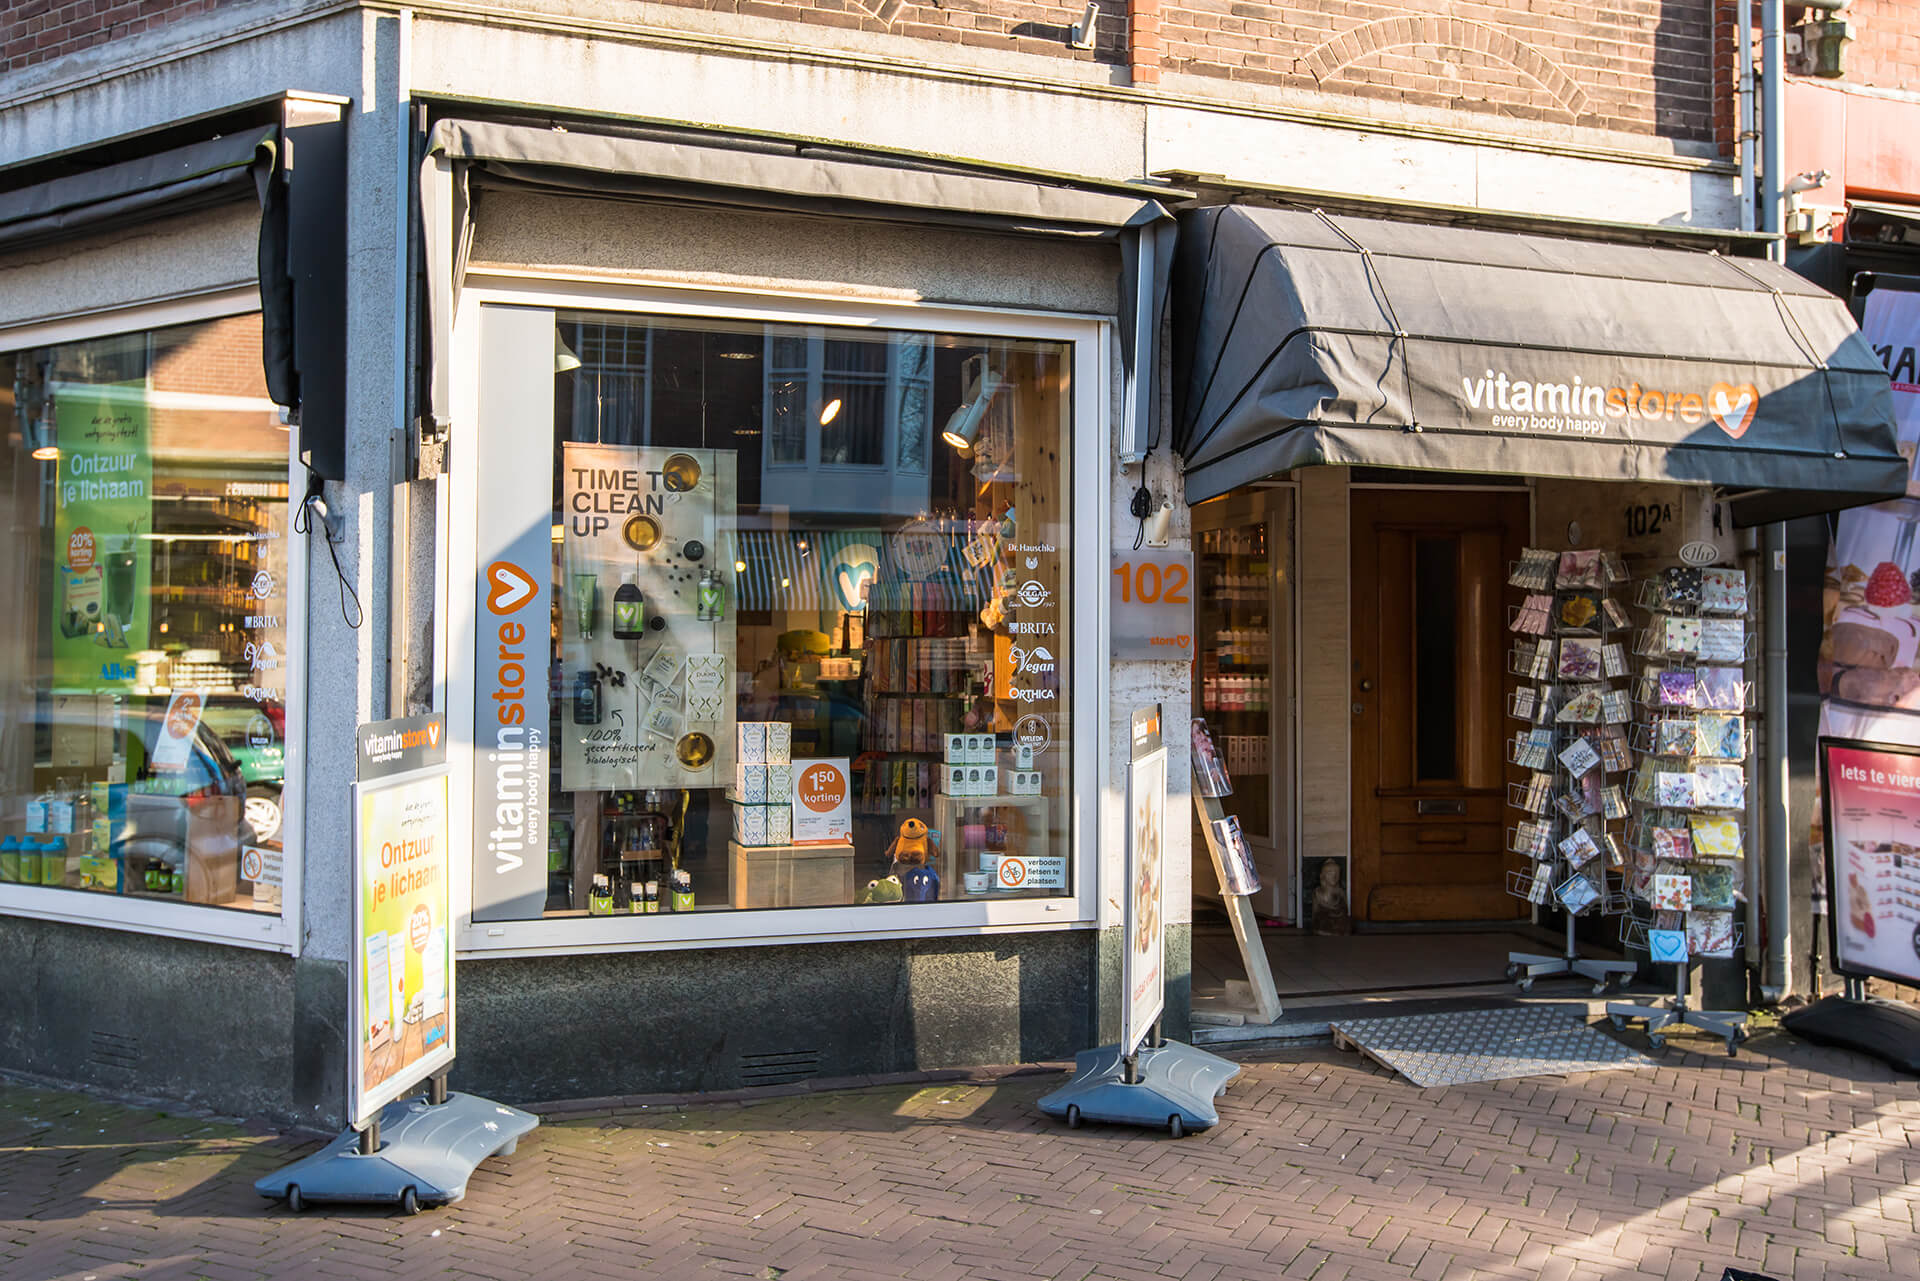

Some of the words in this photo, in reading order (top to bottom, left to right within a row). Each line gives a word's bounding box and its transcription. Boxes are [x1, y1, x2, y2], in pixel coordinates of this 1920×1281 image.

[1462, 368, 1704, 425] vitaminstore
[1492, 415, 1529, 432] every
[1530, 416, 1564, 432] body
[1566, 417, 1607, 435] happy
[71, 453, 137, 476] Ontzuur
[572, 468, 638, 491] TIME
[646, 471, 683, 493] TO
[62, 480, 76, 509] je
[81, 478, 144, 501] lichaam
[572, 492, 664, 515] CLEAN
[572, 515, 609, 538] UP
[1020, 543, 1055, 552] Hauschka
[1112, 562, 1189, 604] 102
[252, 615, 278, 628] BRITA
[1020, 622, 1055, 634] BRITA
[244, 641, 278, 671] Vegan
[1008, 646, 1055, 674] Vegan
[1008, 687, 1055, 704] ORTHICA
[364, 729, 427, 756] vitaminstore
[587, 729, 622, 741] 100%
[487, 621, 526, 875] vitaminstore
[526, 727, 541, 770] happy
[584, 743, 656, 757] gecertificeerd
[526, 771, 541, 806] body
[1870, 768, 1885, 784] te
[804, 793, 841, 804] korting
[527, 807, 541, 844] every
[381, 834, 435, 869] Ontzuur
[372, 879, 386, 913] je
[391, 863, 440, 899] lichaam
